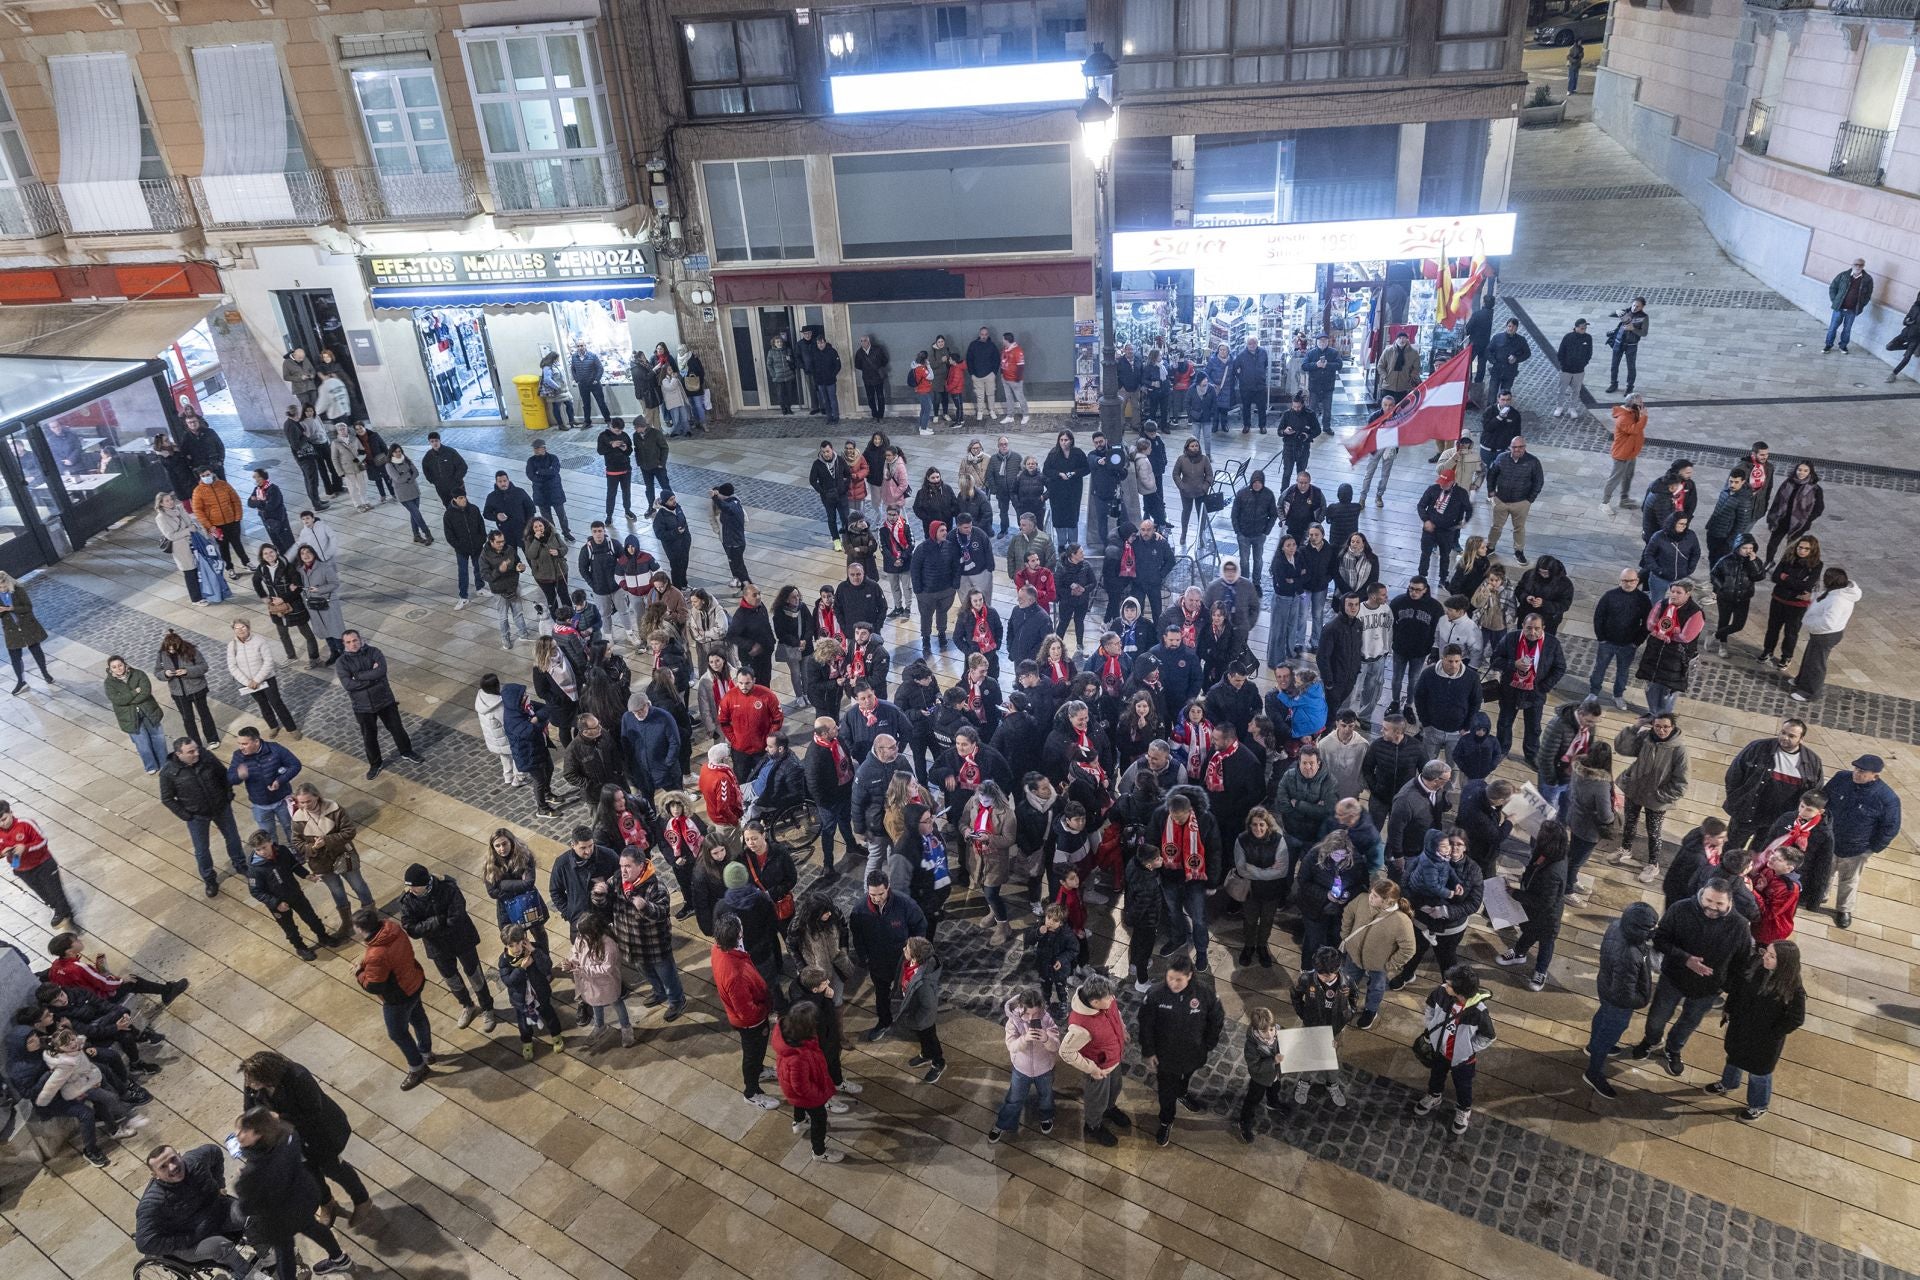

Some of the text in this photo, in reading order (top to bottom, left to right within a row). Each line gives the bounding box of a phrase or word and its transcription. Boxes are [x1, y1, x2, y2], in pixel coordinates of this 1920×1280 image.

[371, 249, 646, 276] EFECTOS NAVALES MENDOZA
